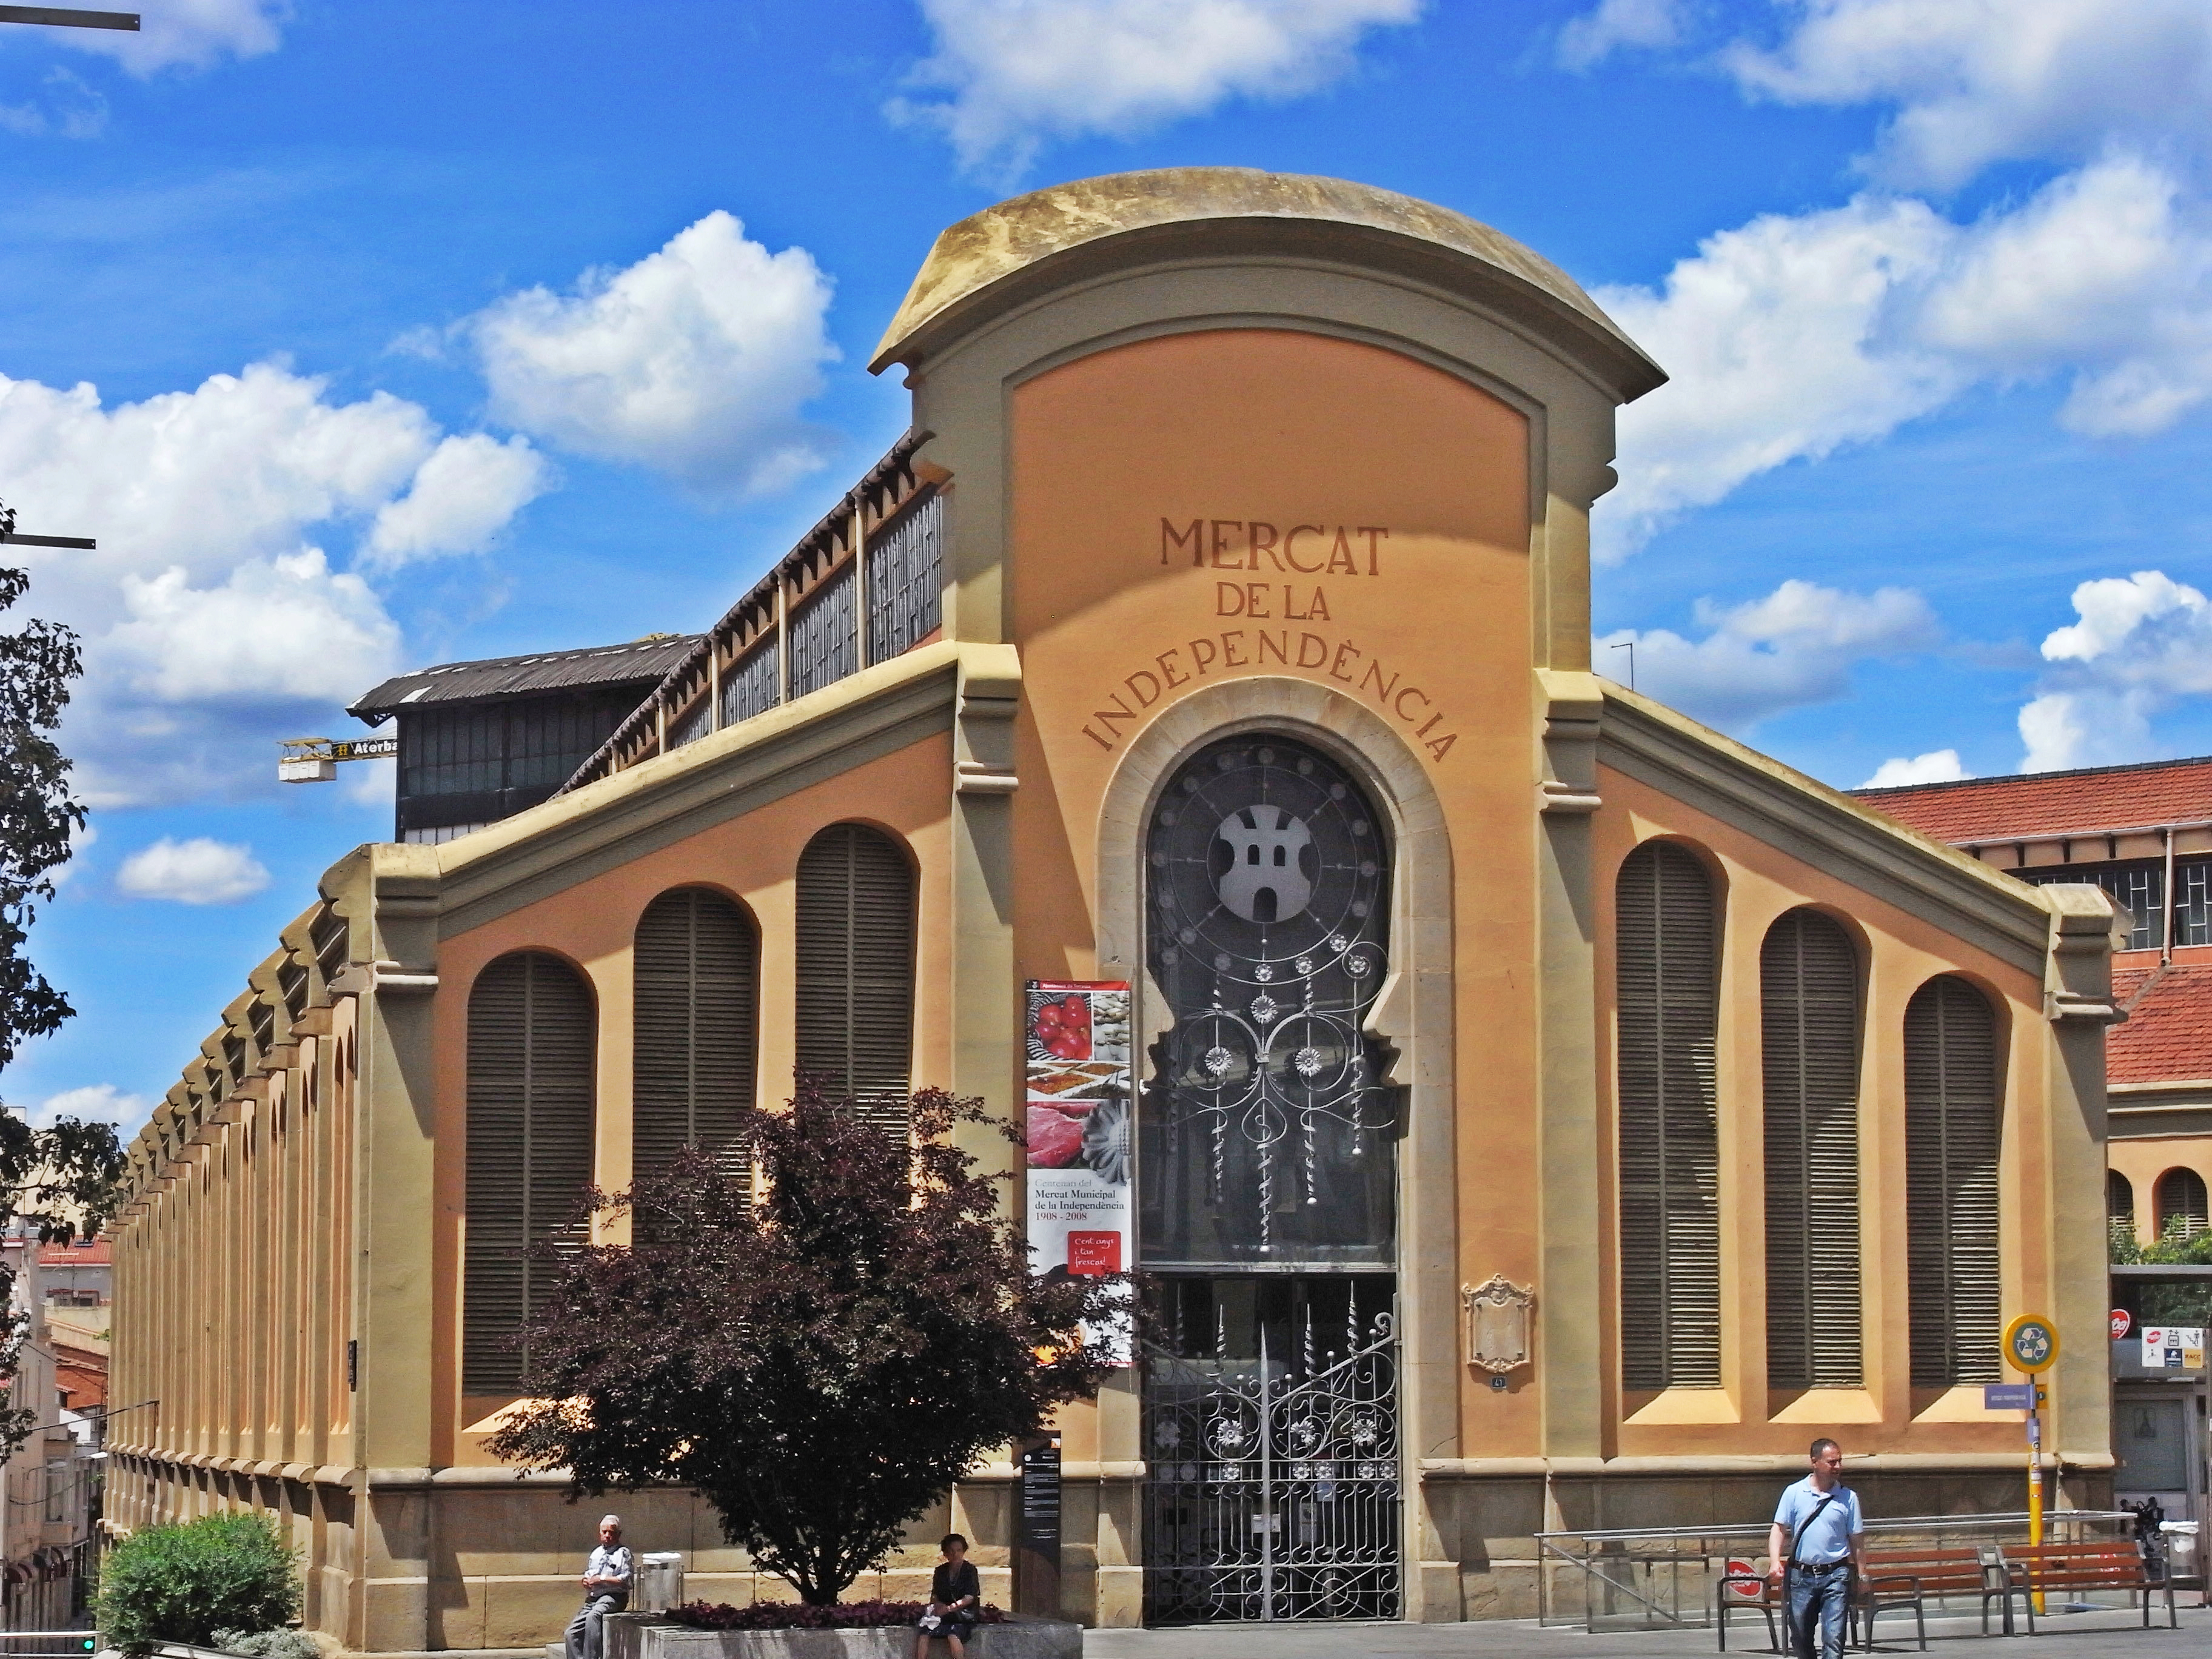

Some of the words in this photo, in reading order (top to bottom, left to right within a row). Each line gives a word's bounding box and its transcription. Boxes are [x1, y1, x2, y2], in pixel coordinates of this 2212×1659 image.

[1161, 517, 1389, 576] MERCAT
[1216, 581, 1270, 618] DE
[1284, 584, 1331, 621] LA
[1081, 628, 1460, 764] INDEPENDÈNCIA
[1036, 1190, 1068, 1198] Mercat
[1071, 1190, 1116, 1199] Municipal
[1060, 1201, 1124, 1211] Independència
[1036, 1212, 1057, 1221] 1908
[1065, 1212, 1087, 1221] 2008
